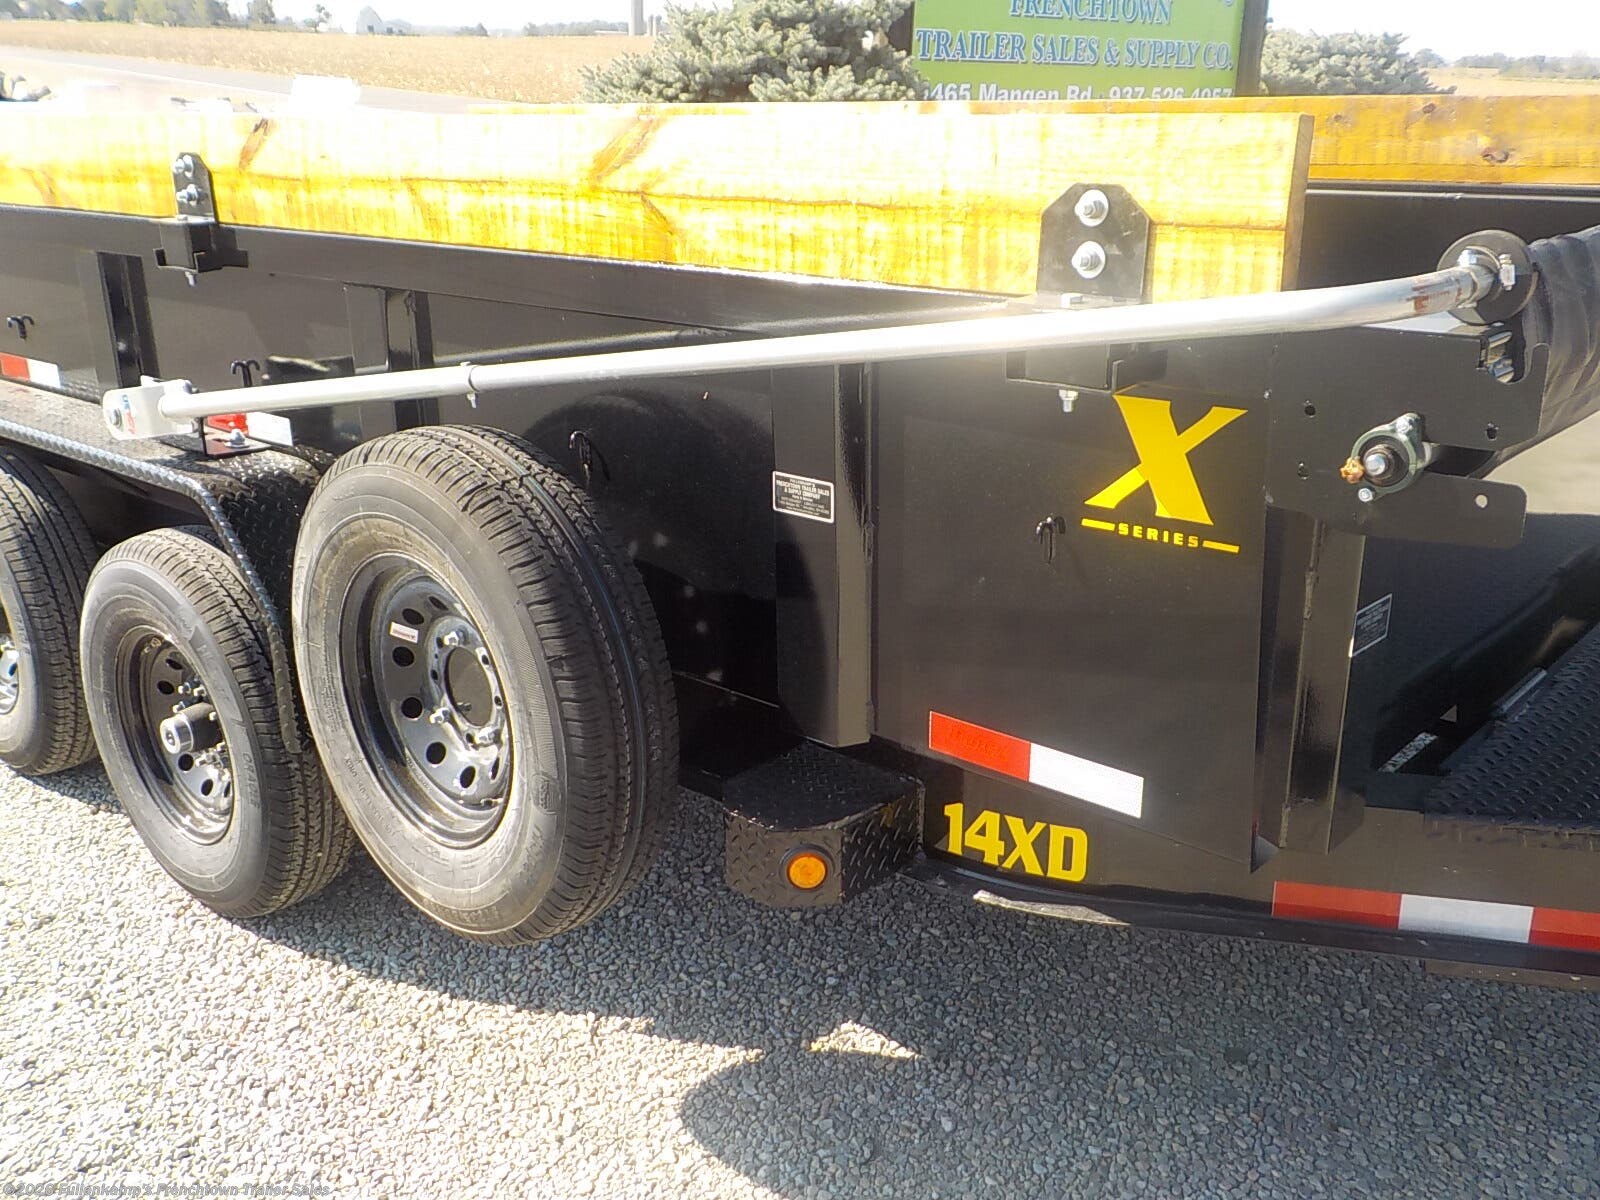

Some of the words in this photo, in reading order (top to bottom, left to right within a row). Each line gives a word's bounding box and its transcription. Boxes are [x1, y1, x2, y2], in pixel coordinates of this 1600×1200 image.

[916, 28, 1027, 63] TRAILER
[1031, 34, 1100, 65] SALES
[1104, 38, 1121, 67] &
[1124, 38, 1200, 68] SUPPLY
[924, 83, 971, 100] 465
[1084, 394, 1248, 525] X
[1118, 522, 1199, 548] SERIES
[944, 802, 1088, 882] 14XD
